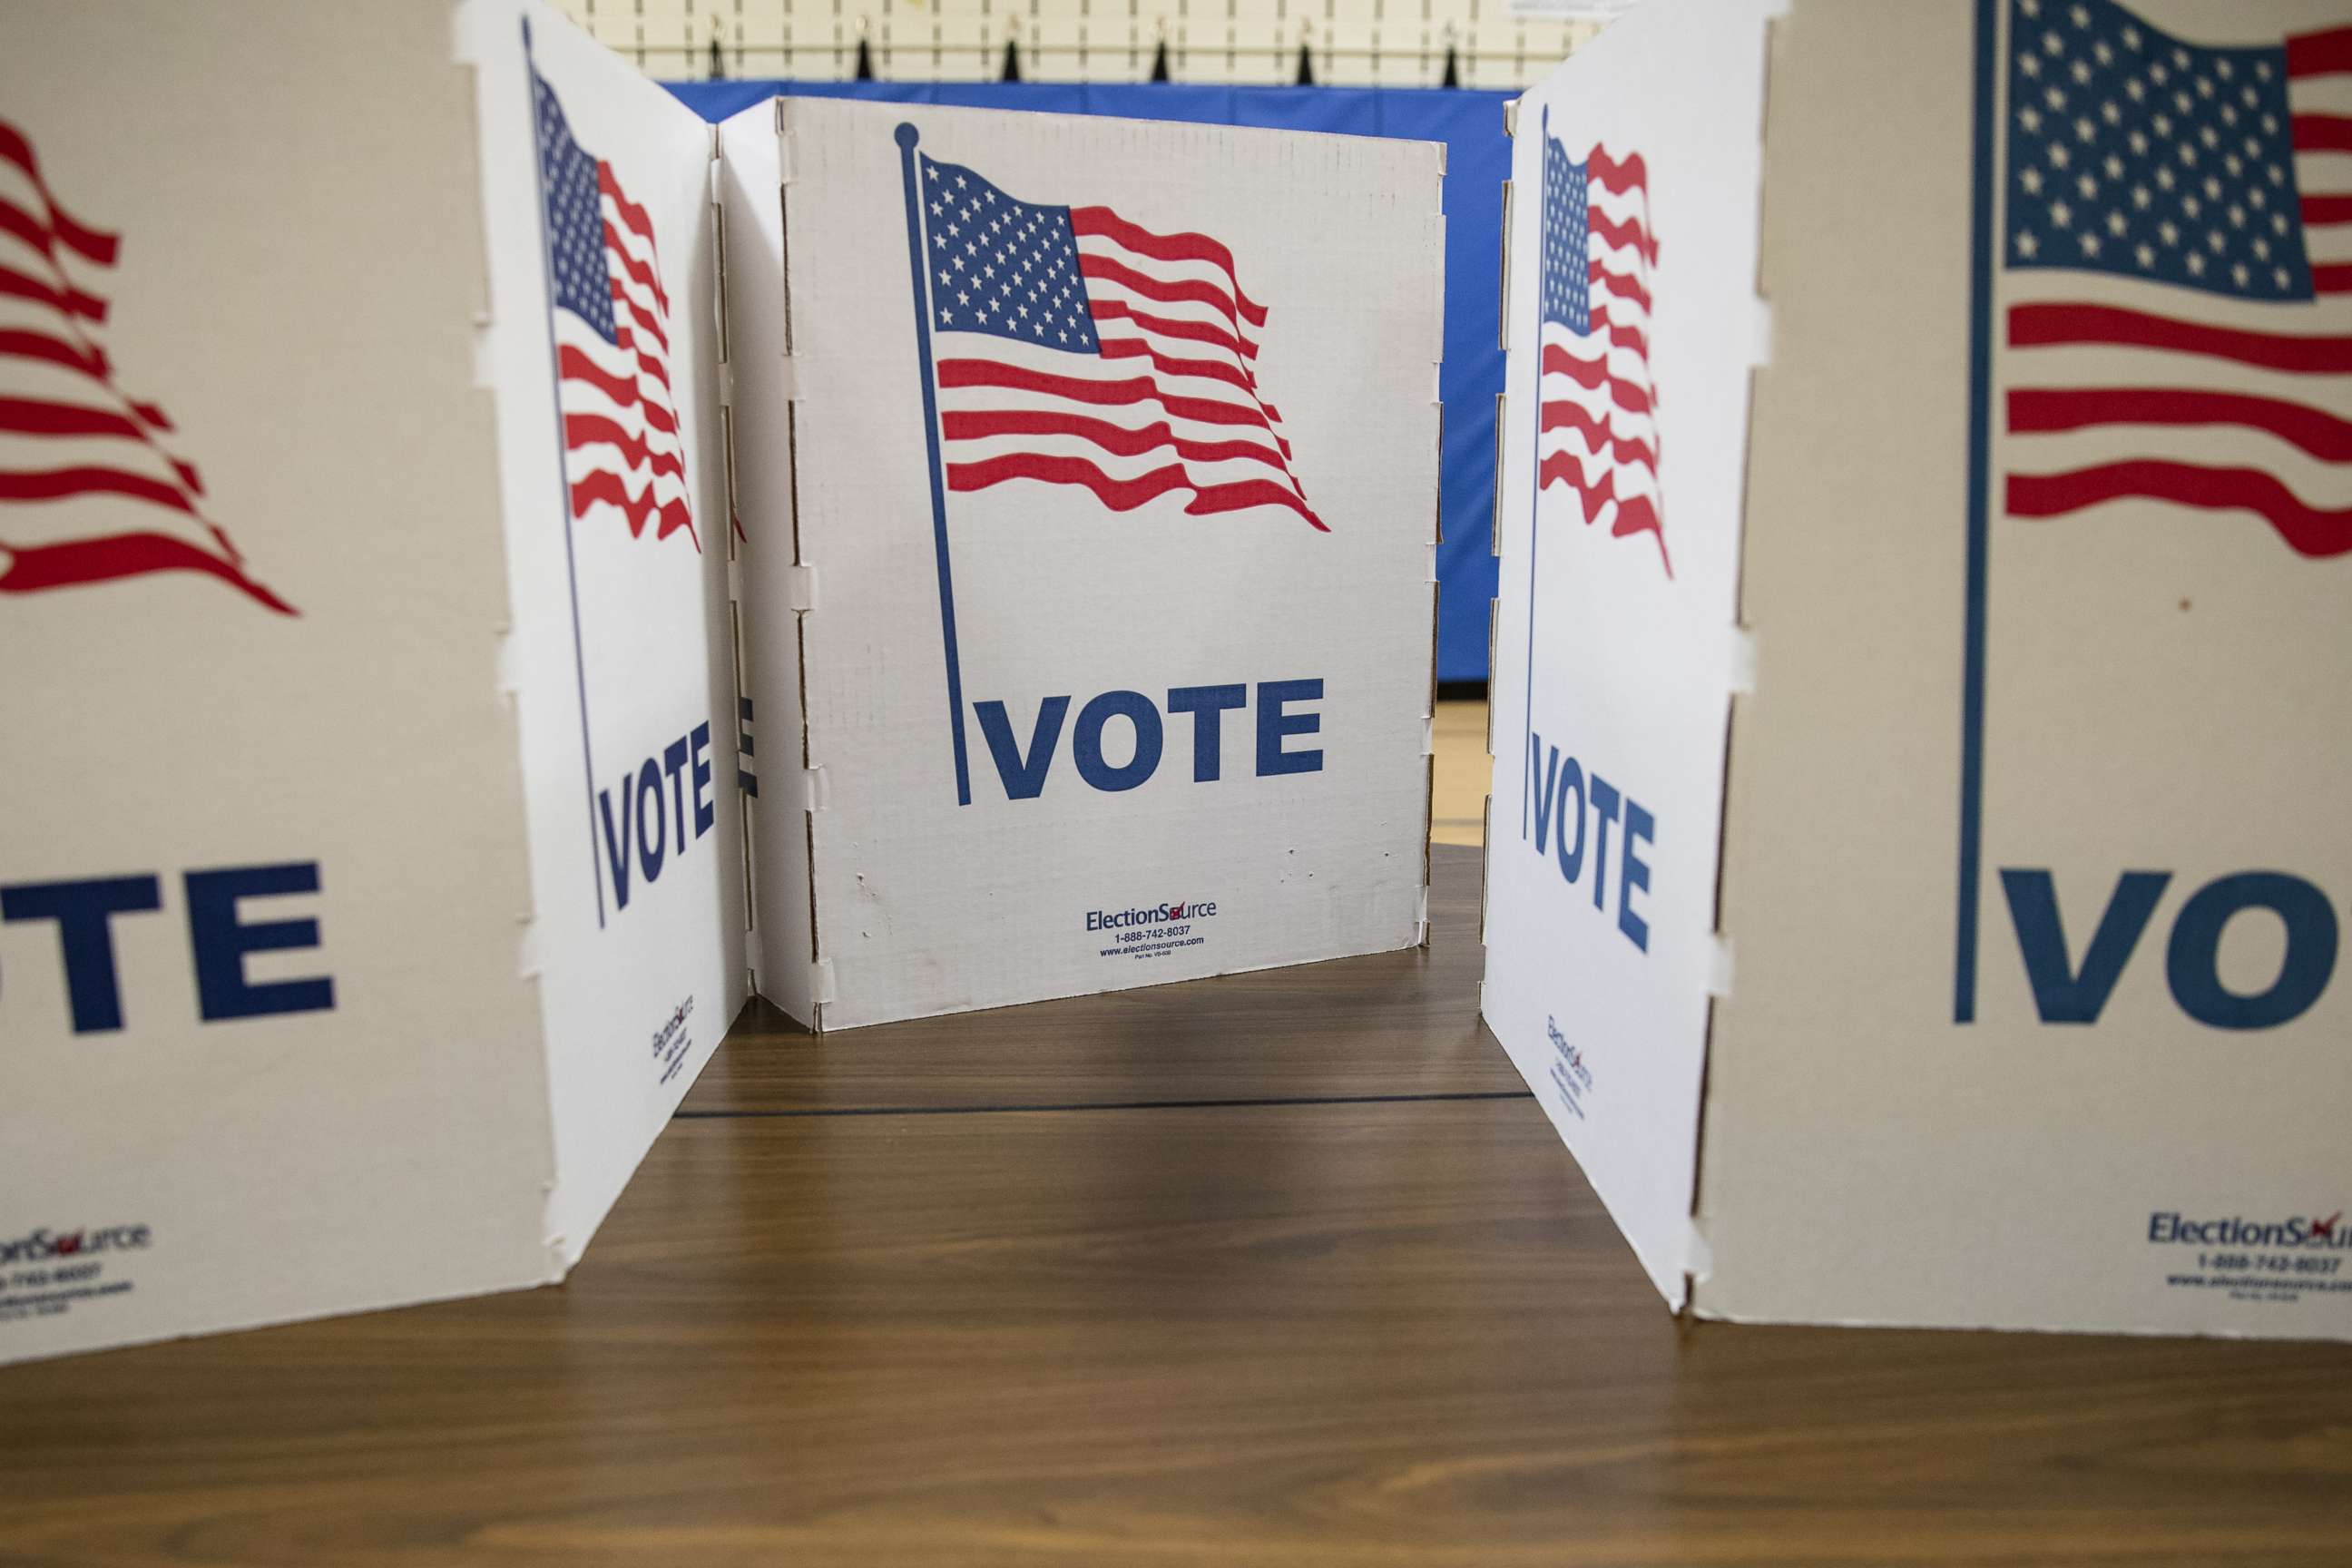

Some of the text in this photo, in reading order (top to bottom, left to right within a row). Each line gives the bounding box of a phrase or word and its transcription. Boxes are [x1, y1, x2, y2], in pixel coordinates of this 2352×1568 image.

[973, 678, 1324, 800] VOTE
[598, 720, 715, 911] VOTE
[1532, 731, 1656, 956] VOTE
[1086, 901, 1217, 931] ElectionSource
[1115, 925, 1191, 943] 1-888-742-8037
[1100, 936, 1205, 956] www.electionsource.com
[2148, 1210, 2352, 1249] ElectionSou
